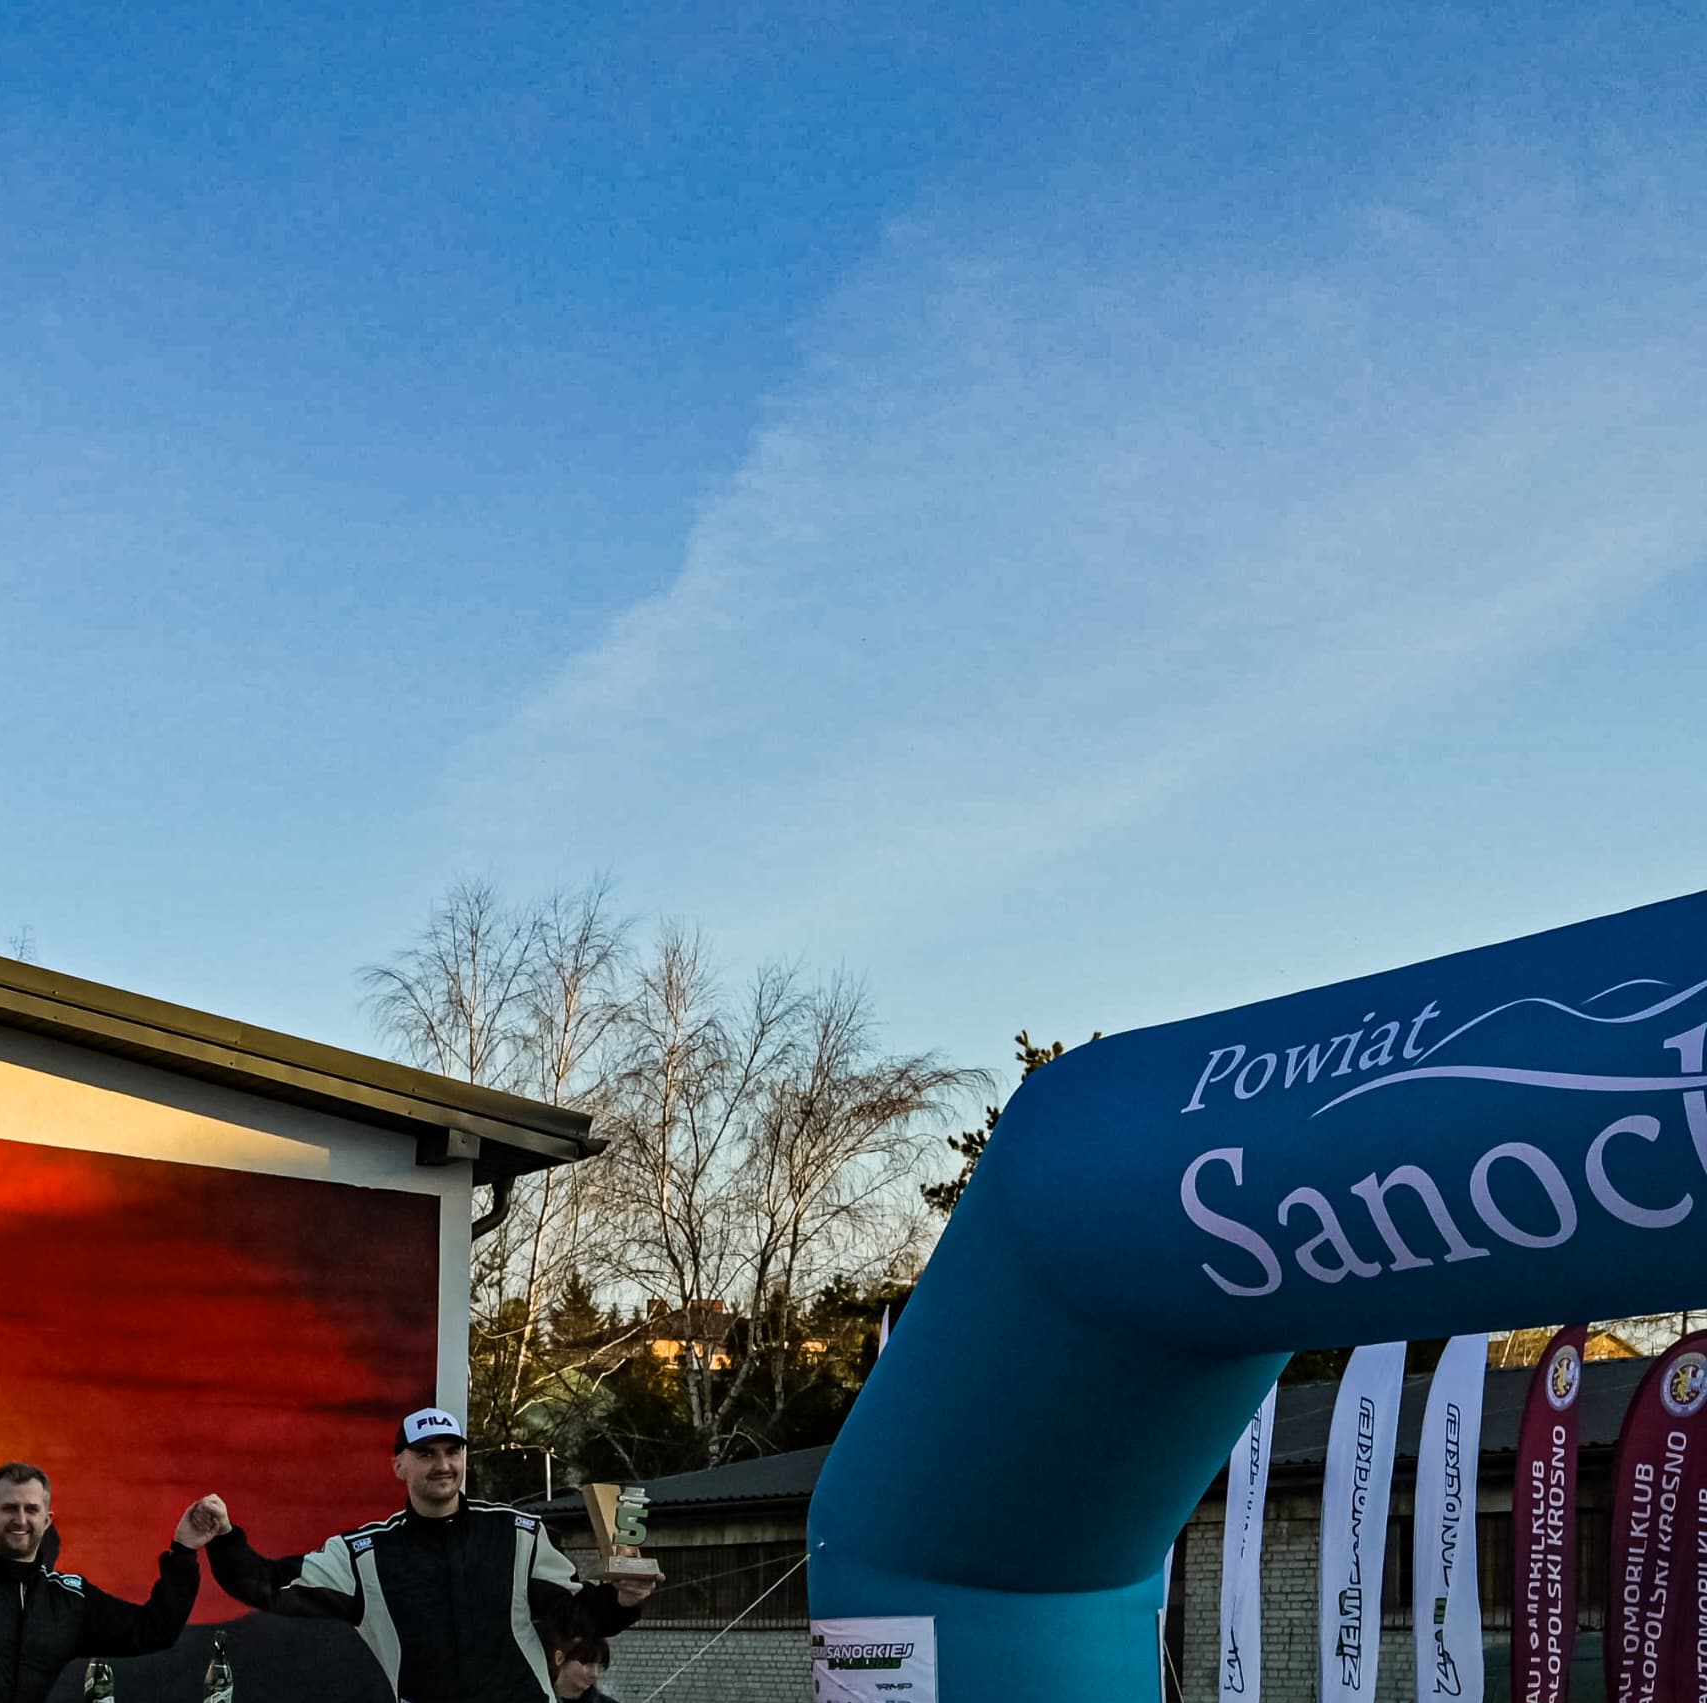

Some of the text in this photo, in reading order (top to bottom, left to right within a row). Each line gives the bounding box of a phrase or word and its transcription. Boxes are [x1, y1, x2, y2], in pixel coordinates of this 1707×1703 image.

[1181, 1000, 1441, 1113] Powiat
[417, 1416, 452, 1430] FILA
[1548, 1424, 1567, 1540] KROSNO
[1660, 1431, 1687, 1553] KROSNO
[827, 1642, 915, 1660] SANOCKIEJ
